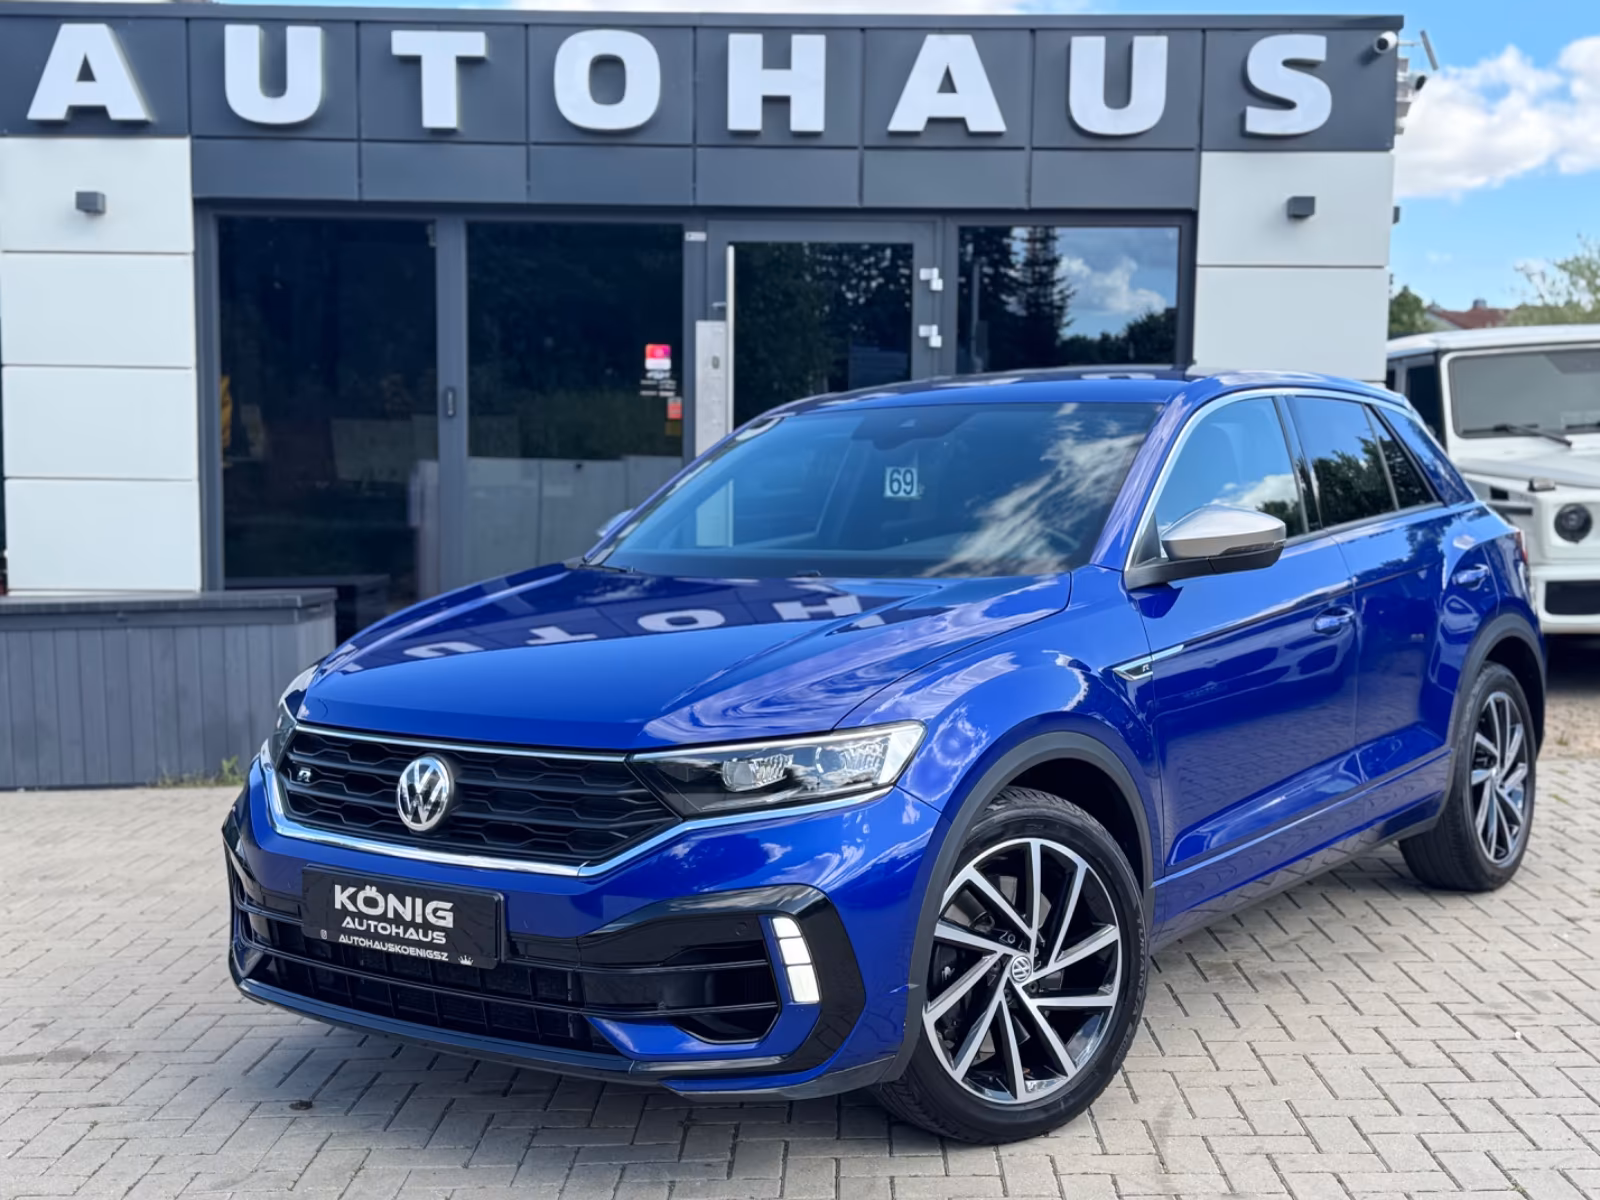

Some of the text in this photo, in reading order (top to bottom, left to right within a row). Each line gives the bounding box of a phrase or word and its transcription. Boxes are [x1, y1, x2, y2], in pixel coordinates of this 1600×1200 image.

[27, 23, 1332, 136] AUTOHAUS
[889, 468, 914, 495] 69
[297, 769, 312, 783] R
[334, 884, 454, 928] KÖNIG
[341, 915, 447, 944] AUTOHAUS
[338, 934, 449, 961] AUTOHAUSKOENIGSZ
